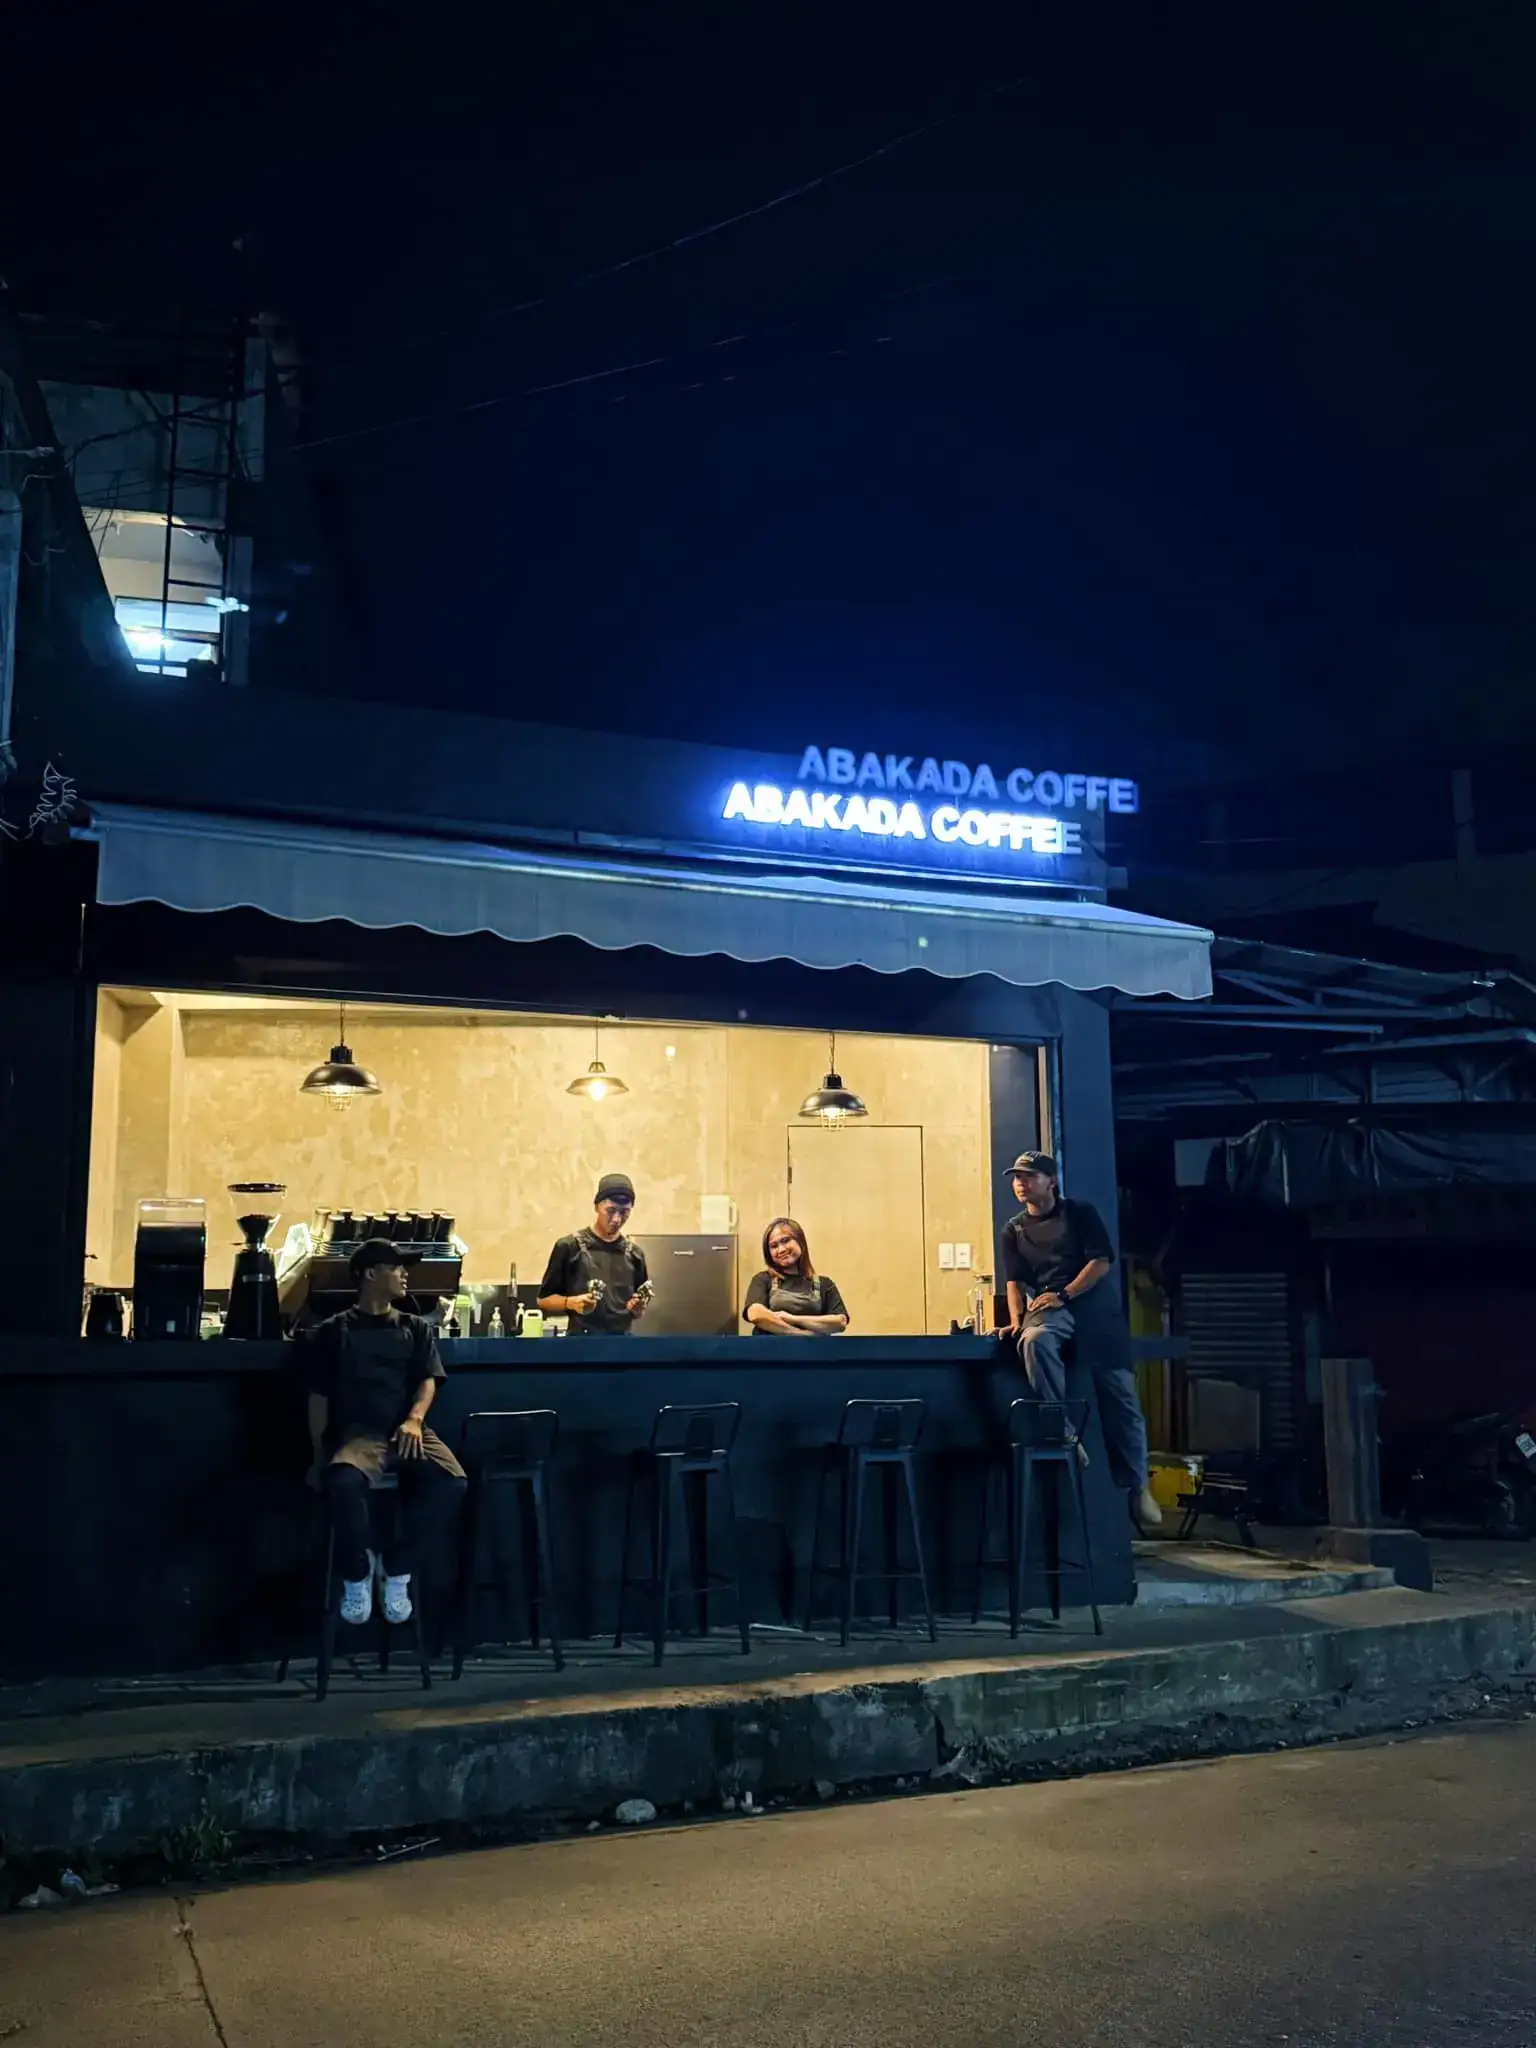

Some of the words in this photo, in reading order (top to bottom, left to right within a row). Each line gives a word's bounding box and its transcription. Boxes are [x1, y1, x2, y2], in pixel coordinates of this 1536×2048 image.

[797, 745, 999, 800] ABAKADA
[722, 781, 926, 839] ABAKADA
[931, 804, 1082, 854] COFFEE
